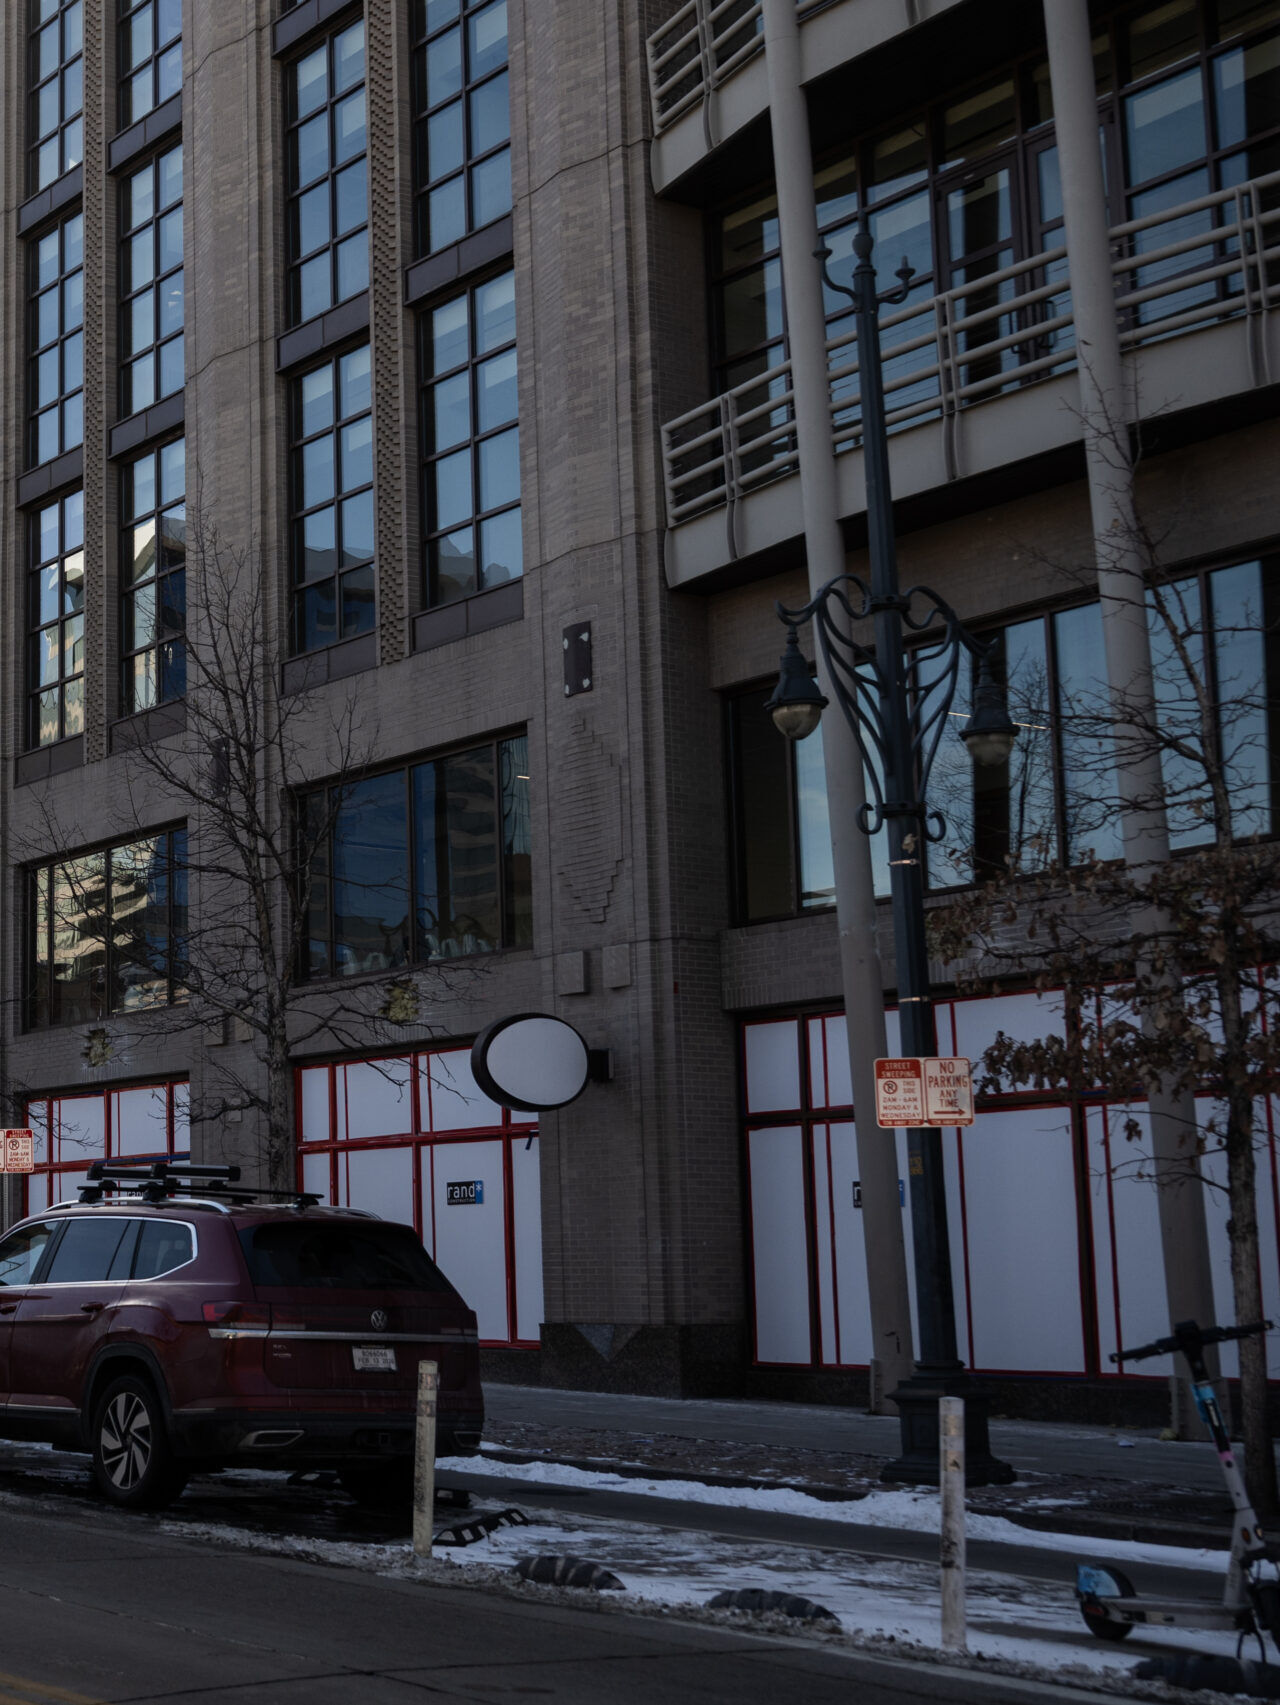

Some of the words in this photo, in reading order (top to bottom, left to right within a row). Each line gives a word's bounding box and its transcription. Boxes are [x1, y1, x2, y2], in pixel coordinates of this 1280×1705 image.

[885, 1062, 911, 1070] STREET
[939, 1061, 955, 1074] NO
[881, 1070, 916, 1078] SWEEPING
[928, 1075, 968, 1088] PARKING
[939, 1090, 958, 1098] ANY
[940, 1098, 960, 1108] TIME
